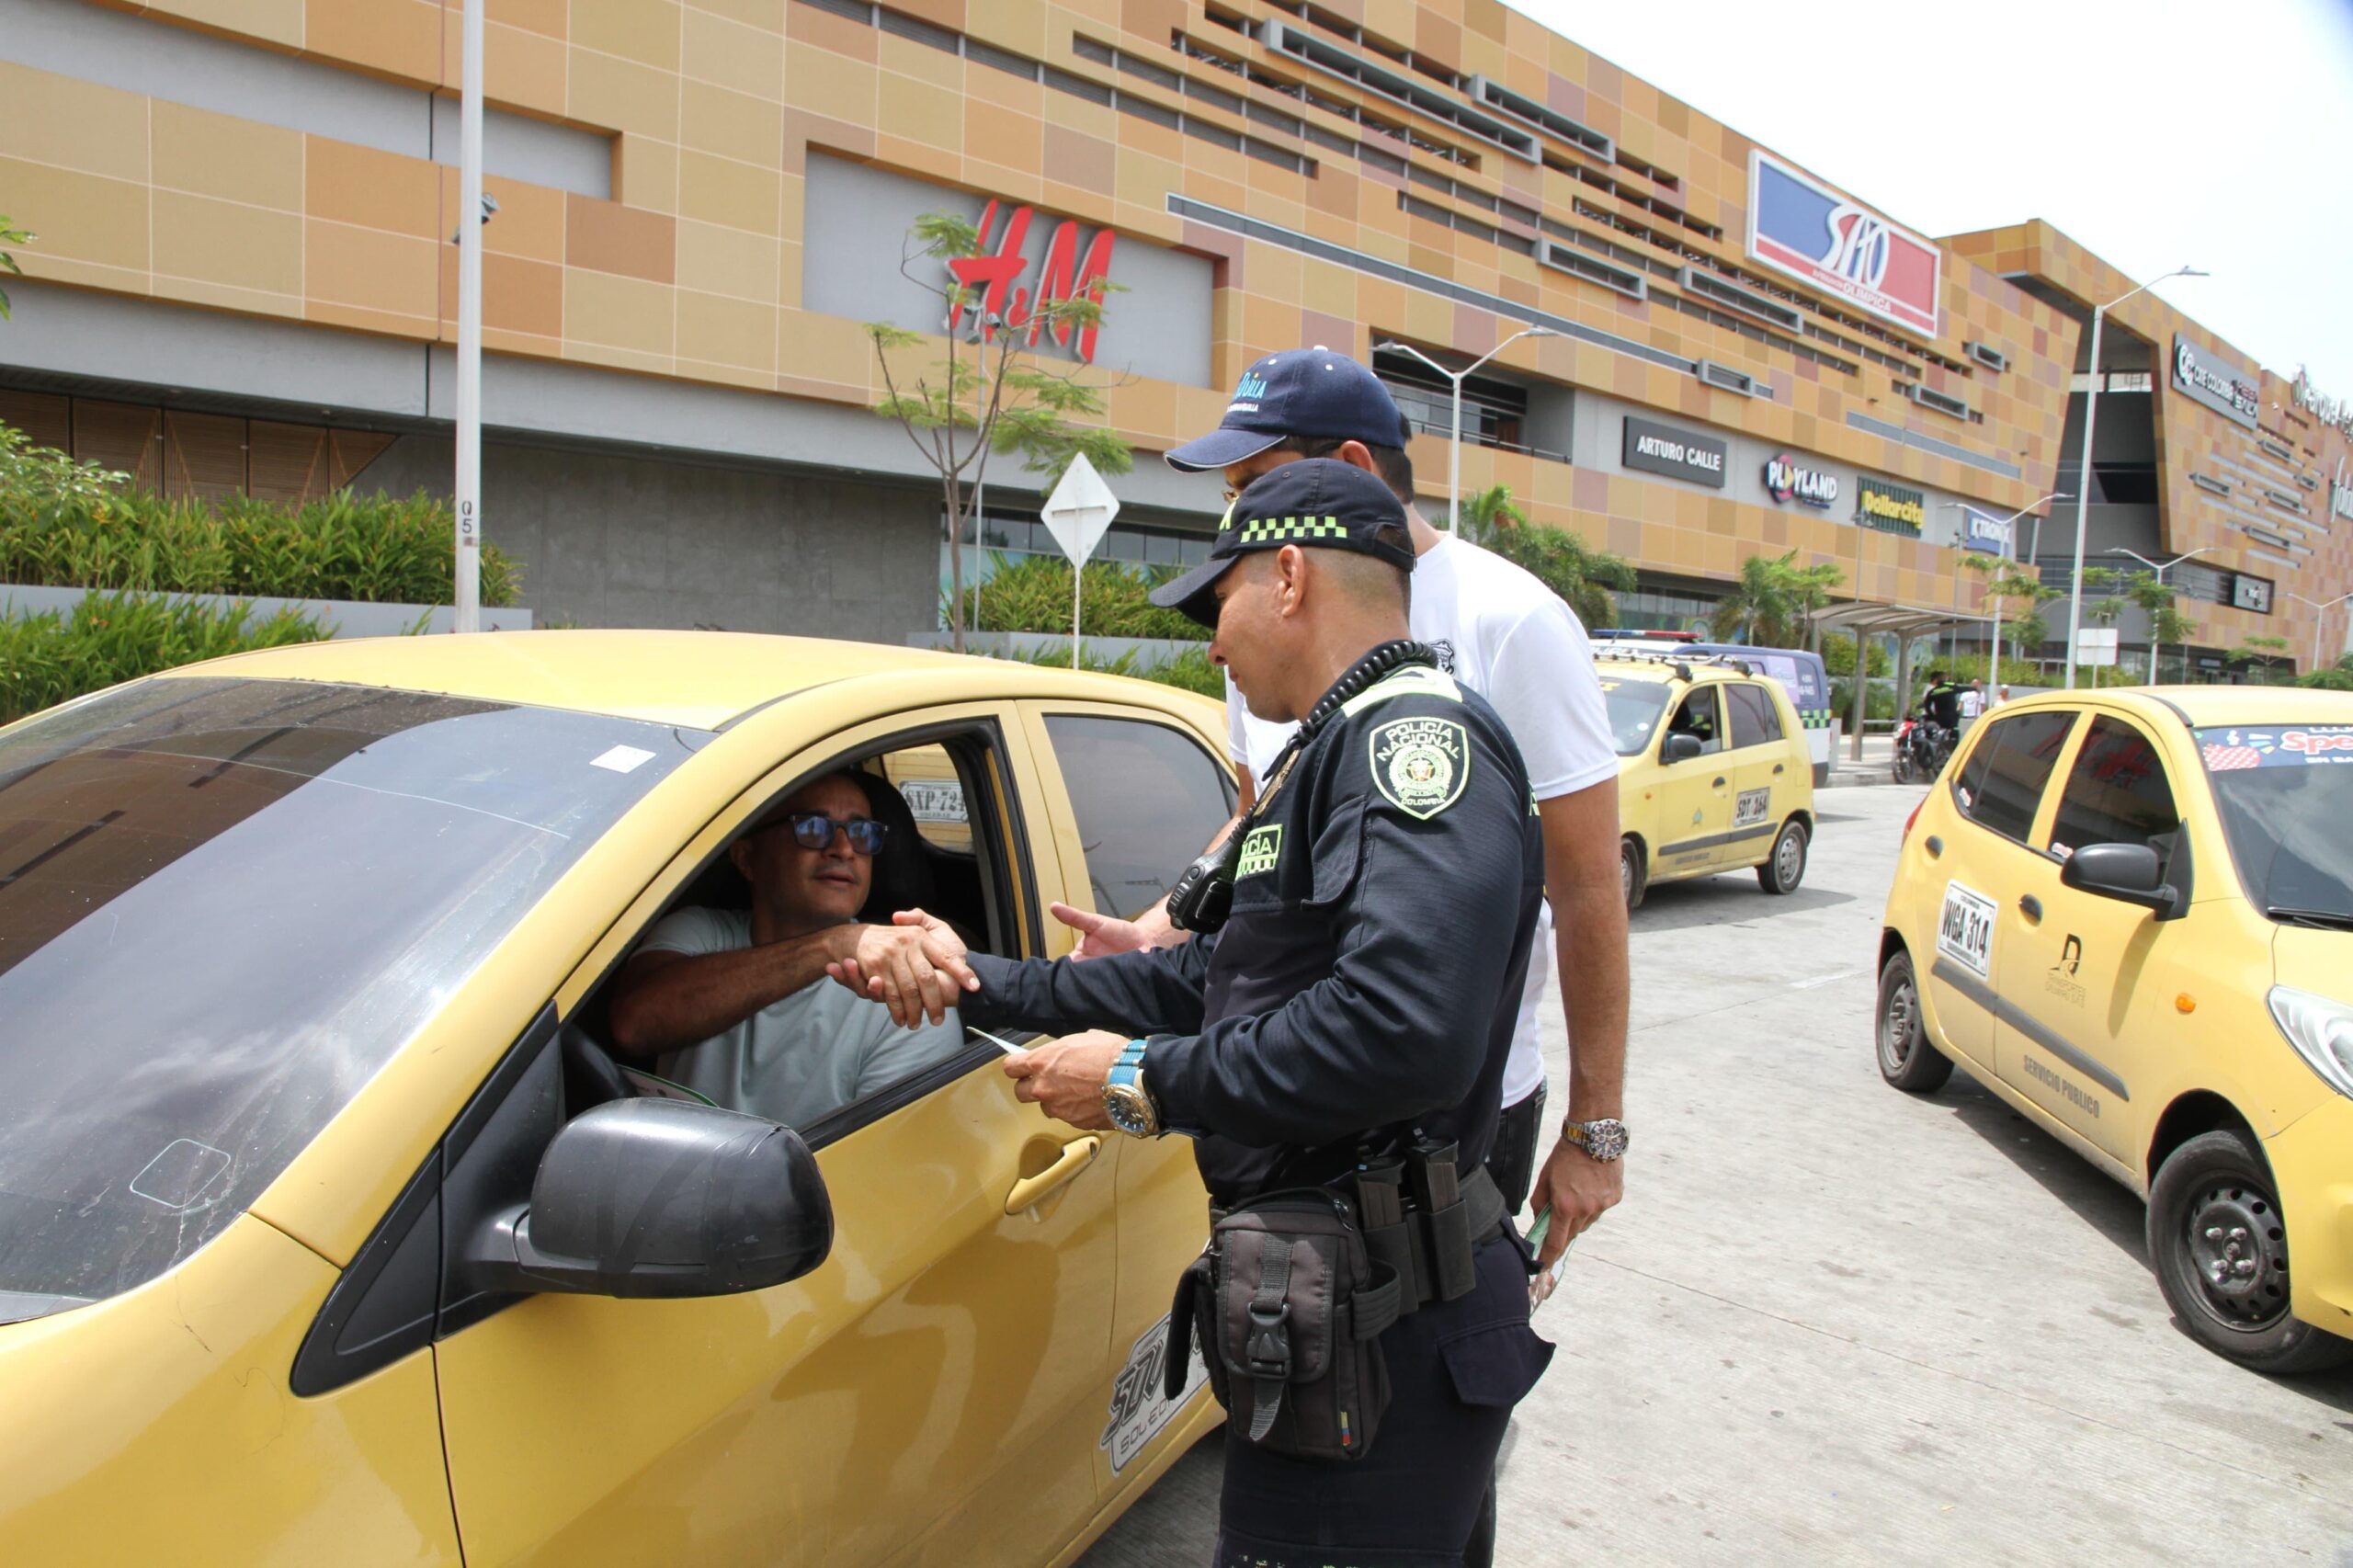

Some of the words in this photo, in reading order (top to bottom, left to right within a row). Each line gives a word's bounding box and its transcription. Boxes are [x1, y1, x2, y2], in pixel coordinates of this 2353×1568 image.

[948, 199, 1115, 364] H&M
[1636, 435, 1685, 463] ARTURO
[1686, 447, 1722, 472] CALLE
[1861, 489, 1927, 529] Dollarcity
[1376, 733, 1461, 763] NACIONAL
[1942, 898, 1967, 946] WGA
[1967, 910, 1990, 960] 314
[2023, 1054, 2060, 1094] SERVICIO
[2062, 1077, 2100, 1119] PUBLICO
